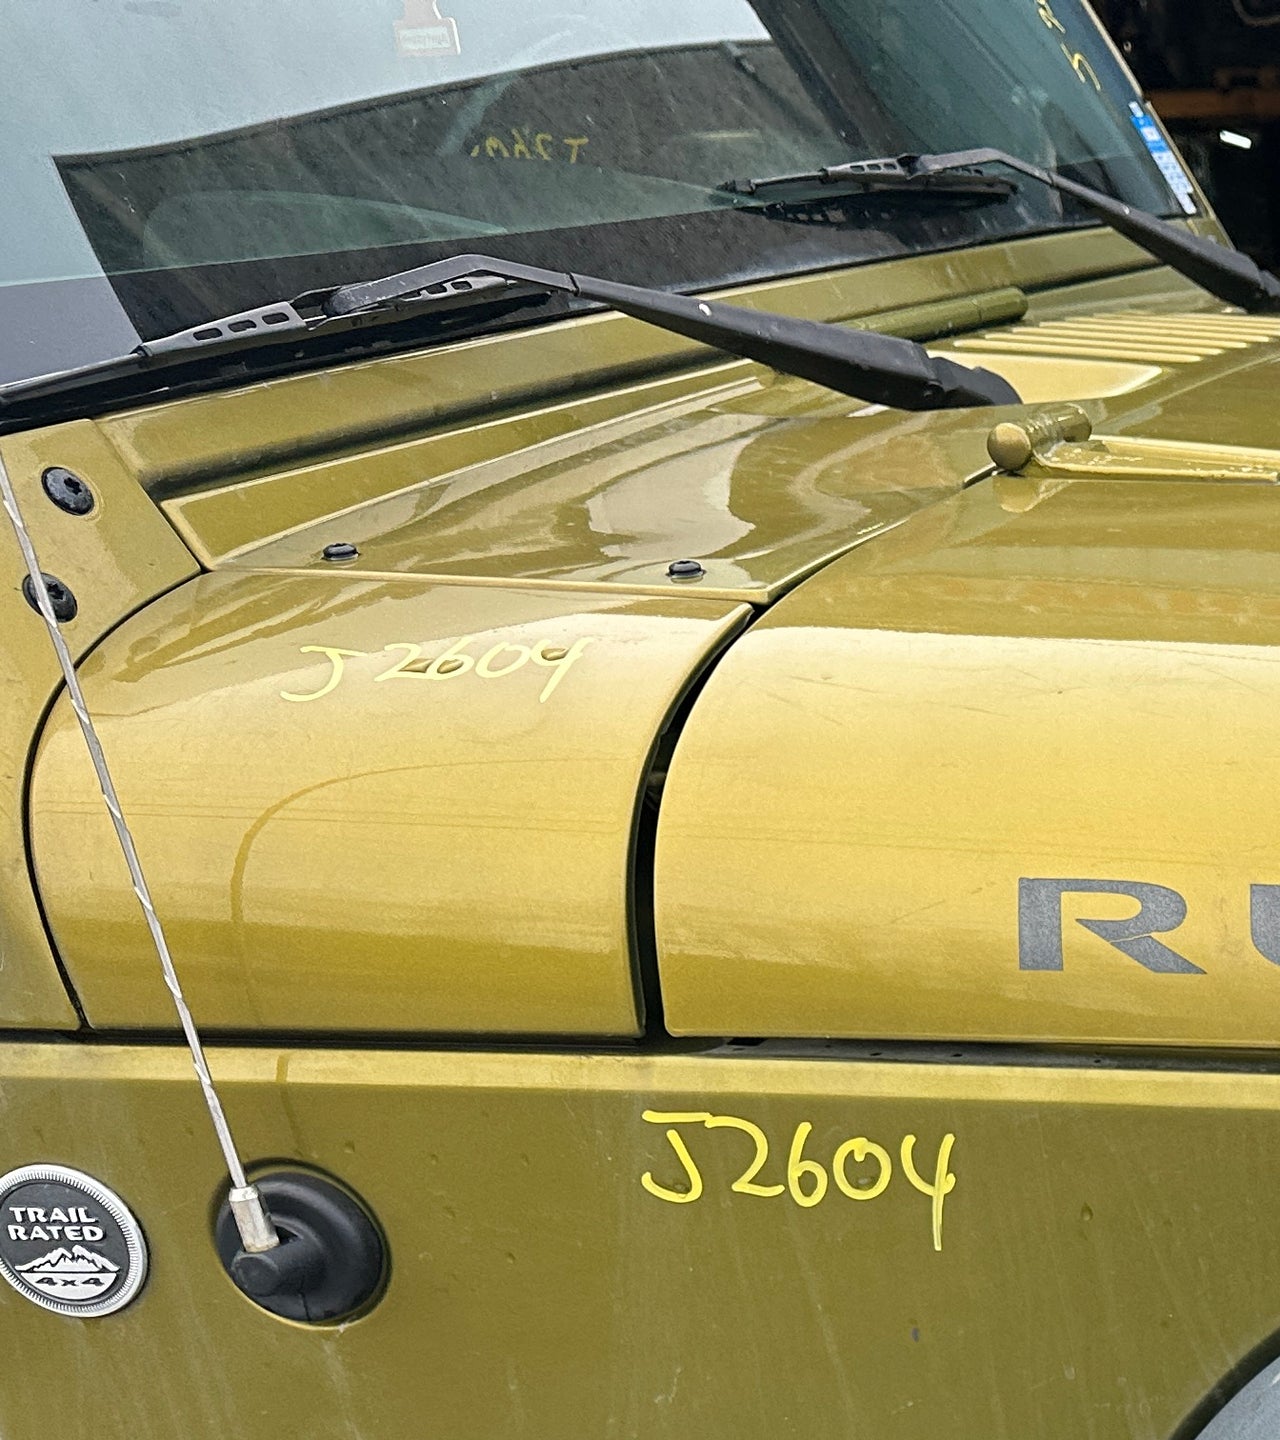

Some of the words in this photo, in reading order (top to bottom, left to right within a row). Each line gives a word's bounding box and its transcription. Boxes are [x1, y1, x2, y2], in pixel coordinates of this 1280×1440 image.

[641, 1109, 957, 1252] J2604
[8, 1205, 97, 1224] TRAIL
[7, 1225, 105, 1242] RATED
